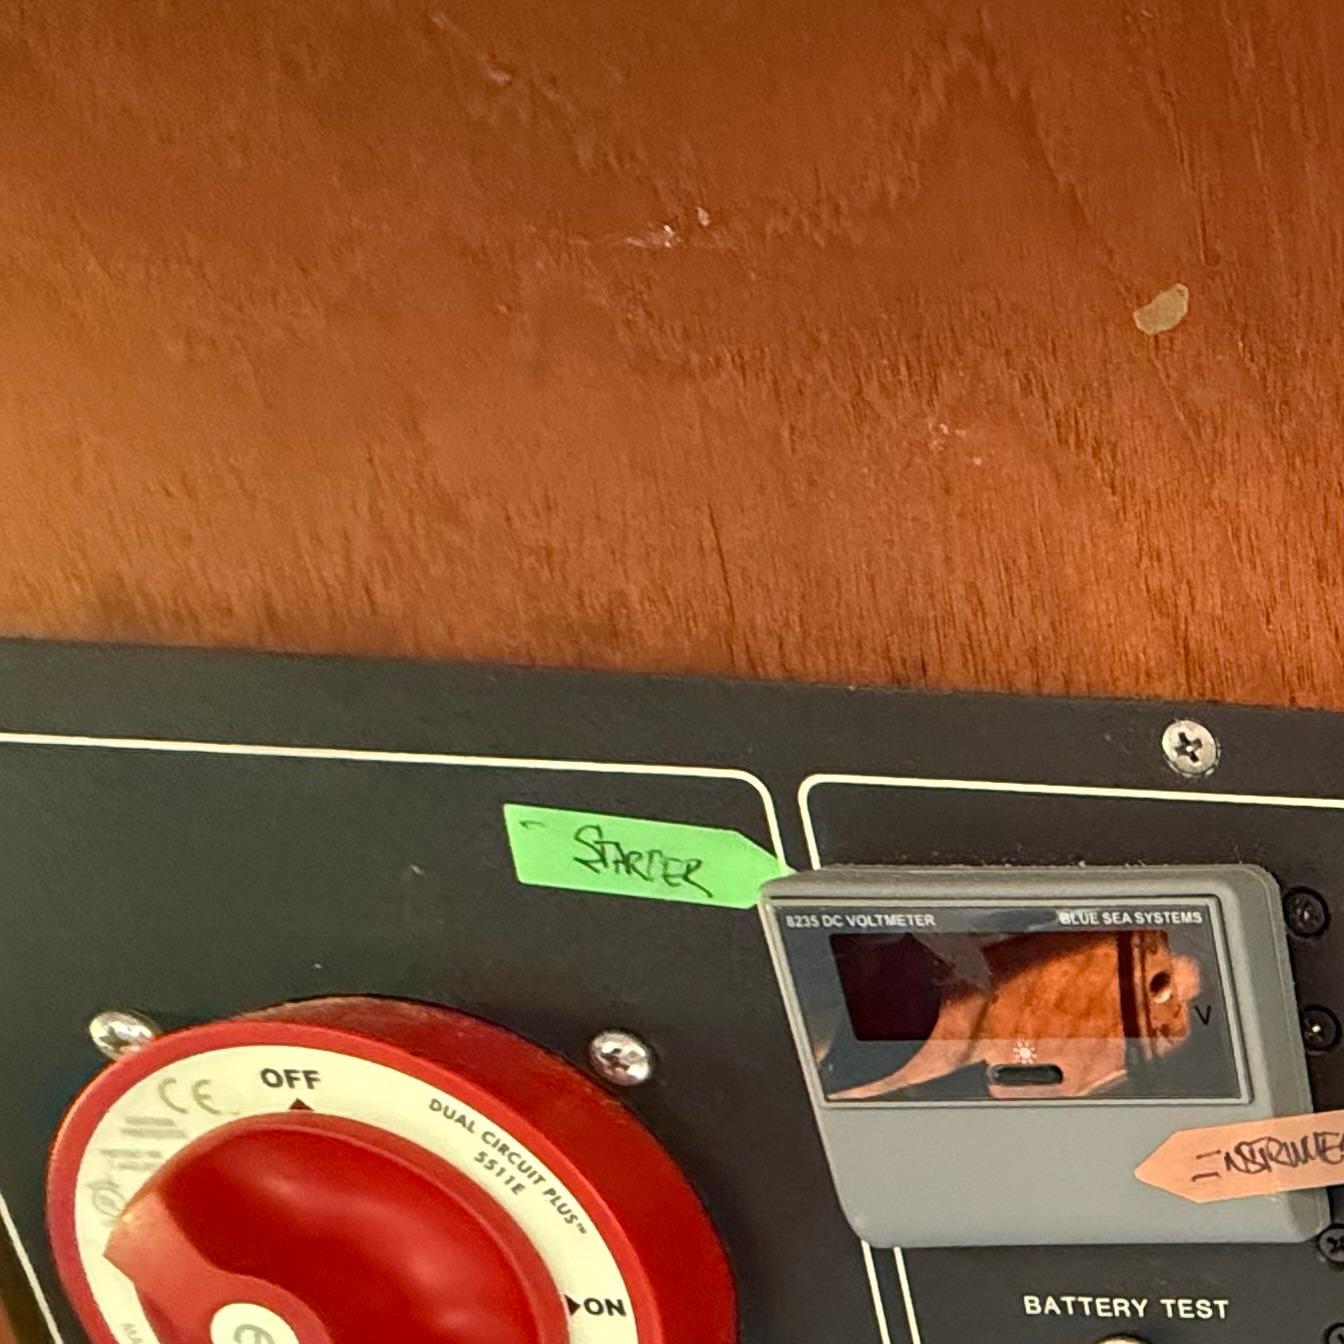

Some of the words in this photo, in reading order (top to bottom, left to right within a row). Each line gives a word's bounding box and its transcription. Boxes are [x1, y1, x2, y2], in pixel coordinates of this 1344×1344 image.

[786, 915, 820, 928] 8235
[822, 915, 843, 927] DC
[846, 914, 936, 928] VOLTMETER
[1059, 912, 1099, 925] BLUE
[1103, 912, 1130, 924] SEA
[1134, 912, 1203, 924] SYSTEMS
[260, 1068, 321, 1089] OFF
[429, 1098, 476, 1133] DUAL
[481, 1131, 546, 1186] CIRCUIT
[474, 1152, 526, 1195] 5511E
[583, 1298, 627, 1316] ON
[1023, 1295, 1147, 1318] BATTERY
[1160, 1299, 1229, 1319] TEST
